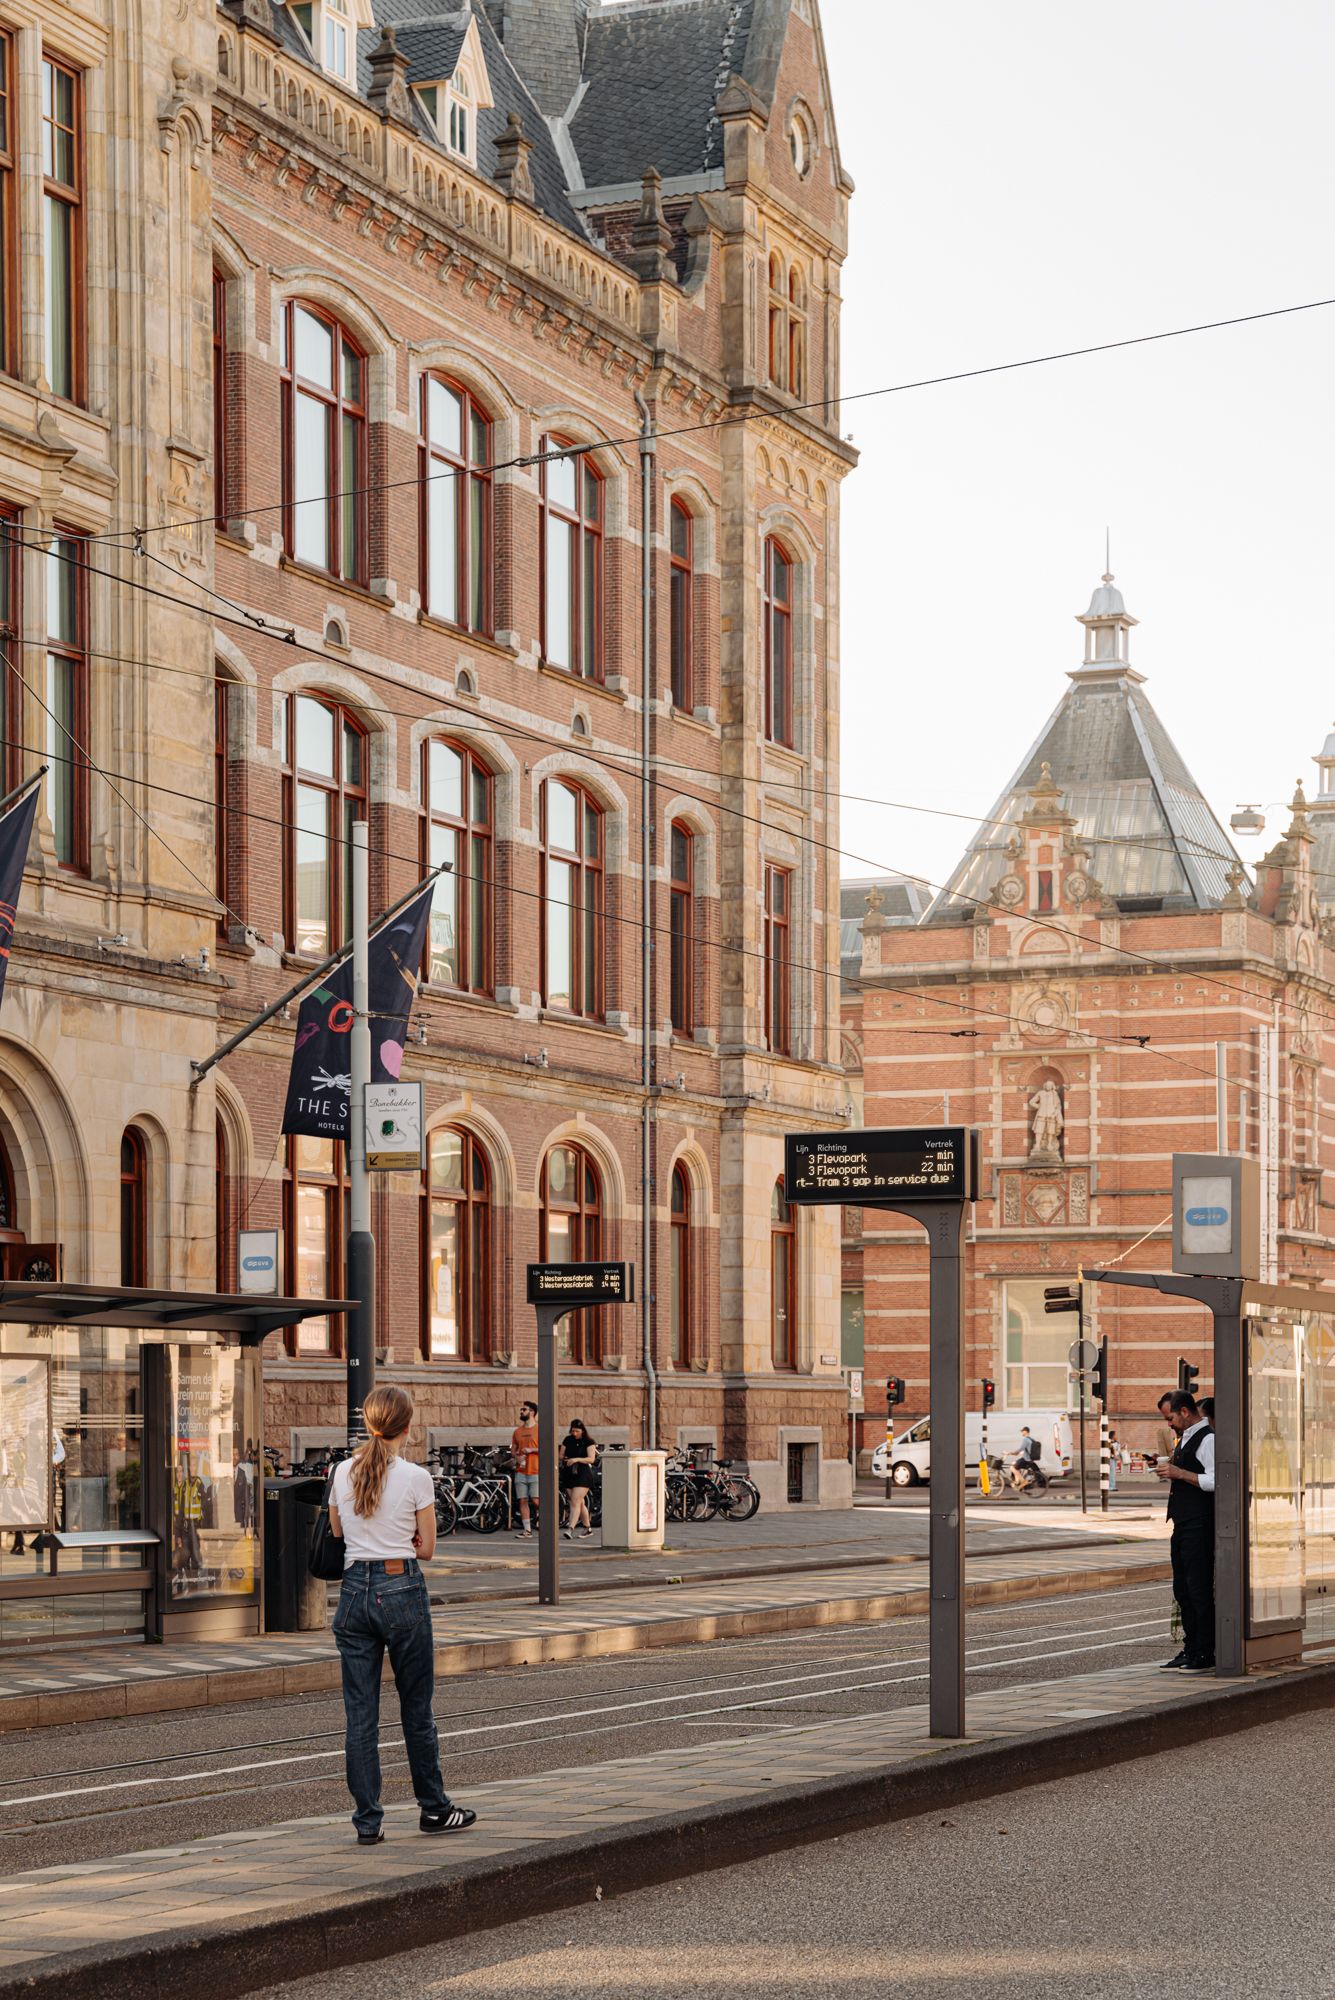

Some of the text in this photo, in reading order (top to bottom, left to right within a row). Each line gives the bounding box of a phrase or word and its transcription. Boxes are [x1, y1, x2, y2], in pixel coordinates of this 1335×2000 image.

[298, 1097, 331, 1116] THE
[318, 1122, 345, 1131] HOTELS
[796, 1140, 954, 1154] Lijn Richting Vertrek
[808, 1155, 815, 1164] 3
[817, 1153, 868, 1164] Flevopark
[937, 1151, 954, 1160] min
[808, 1162, 954, 1176] 3 Flevopark 22 min
[816, 1178, 840, 1187] Tram
[843, 1177, 850, 1186] 3
[853, 1177, 870, 1187] gap
[874, 1175, 885, 1185] in
[888, 1174, 927, 1185] service
[930, 1174, 950, 1184] due
